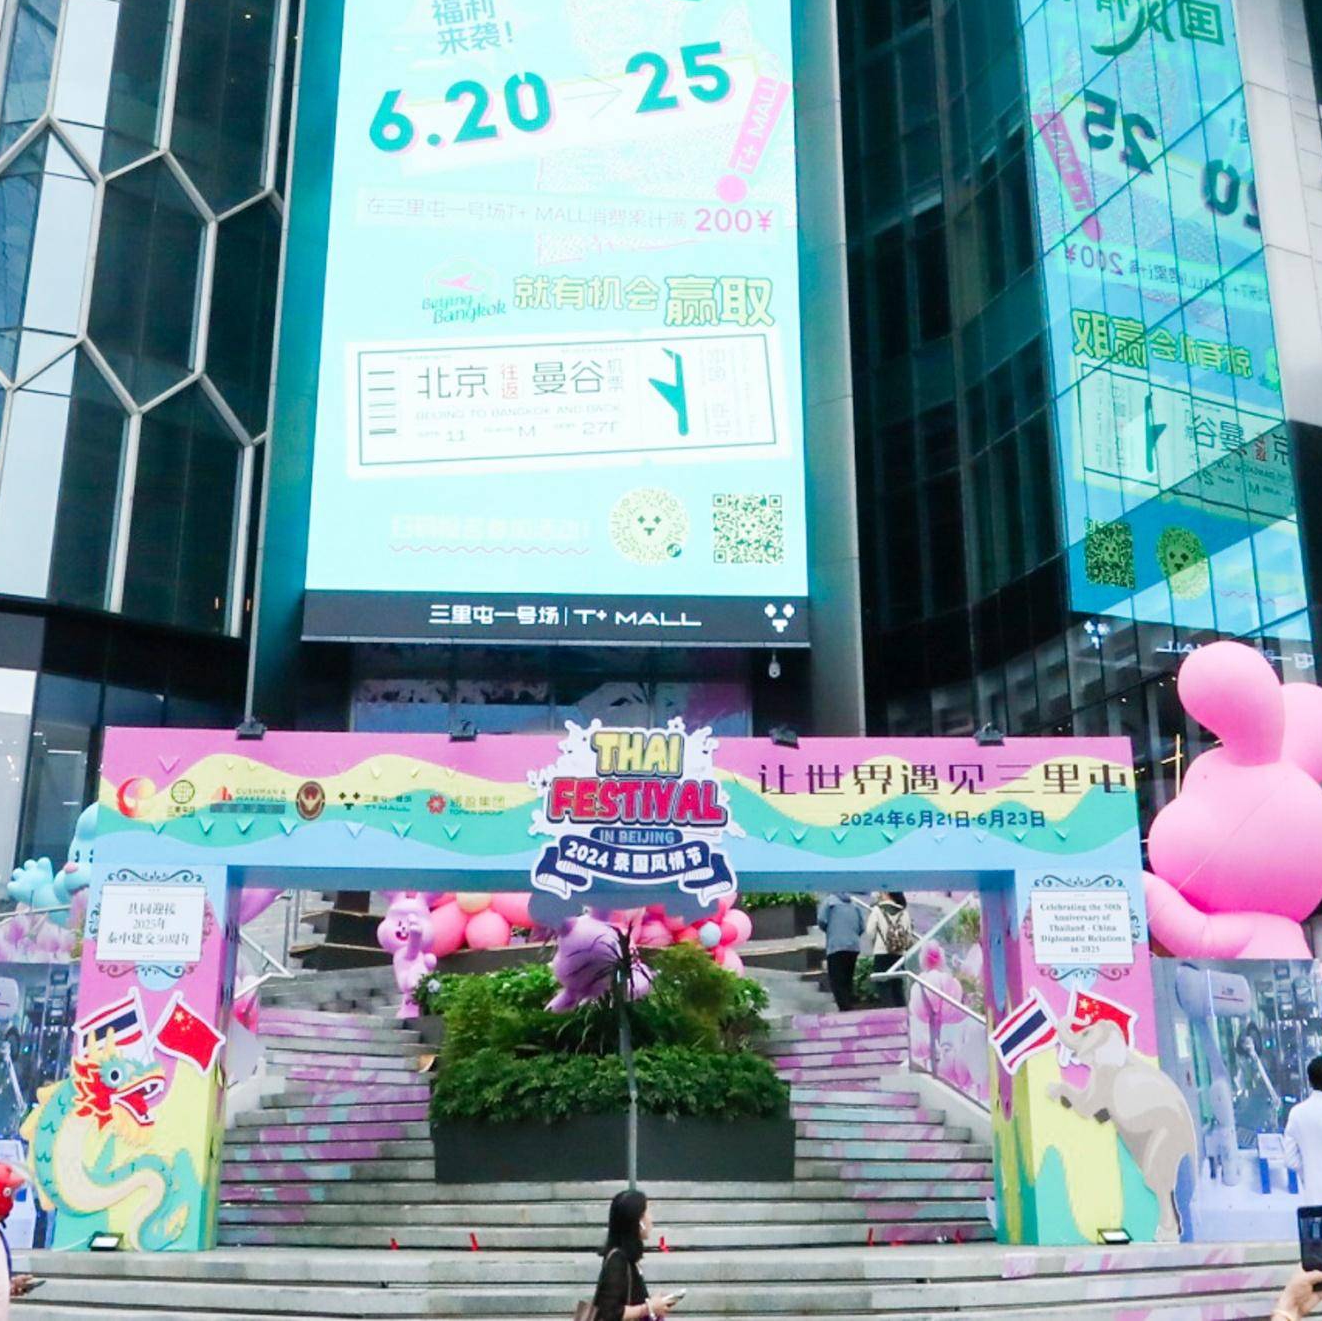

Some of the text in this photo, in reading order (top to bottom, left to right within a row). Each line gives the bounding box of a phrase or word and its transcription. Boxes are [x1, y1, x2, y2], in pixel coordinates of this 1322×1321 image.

[437, 21, 514, 56] 来袭!
[368, 40, 733, 153] 6.20 25
[432, 298, 508, 325] Bangkok
[416, 364, 490, 400] 北京
[531, 359, 606, 396] 曼谷
[428, 603, 560, 626] 三里屯一号场
[615, 610, 703, 627] MALL
[592, 732, 682, 774] THAI
[758, 763, 1128, 796] 让世界遇见三里屯
[550, 777, 724, 820] FESTIVAL
[599, 829, 675, 845] IN BEIJING
[564, 840, 703, 874] 2024 泰国风情节
[1040, 903, 1087, 912] Celebrating
[1089, 903, 1102, 911] the
[1041, 934, 1086, 943] Diplomatic
